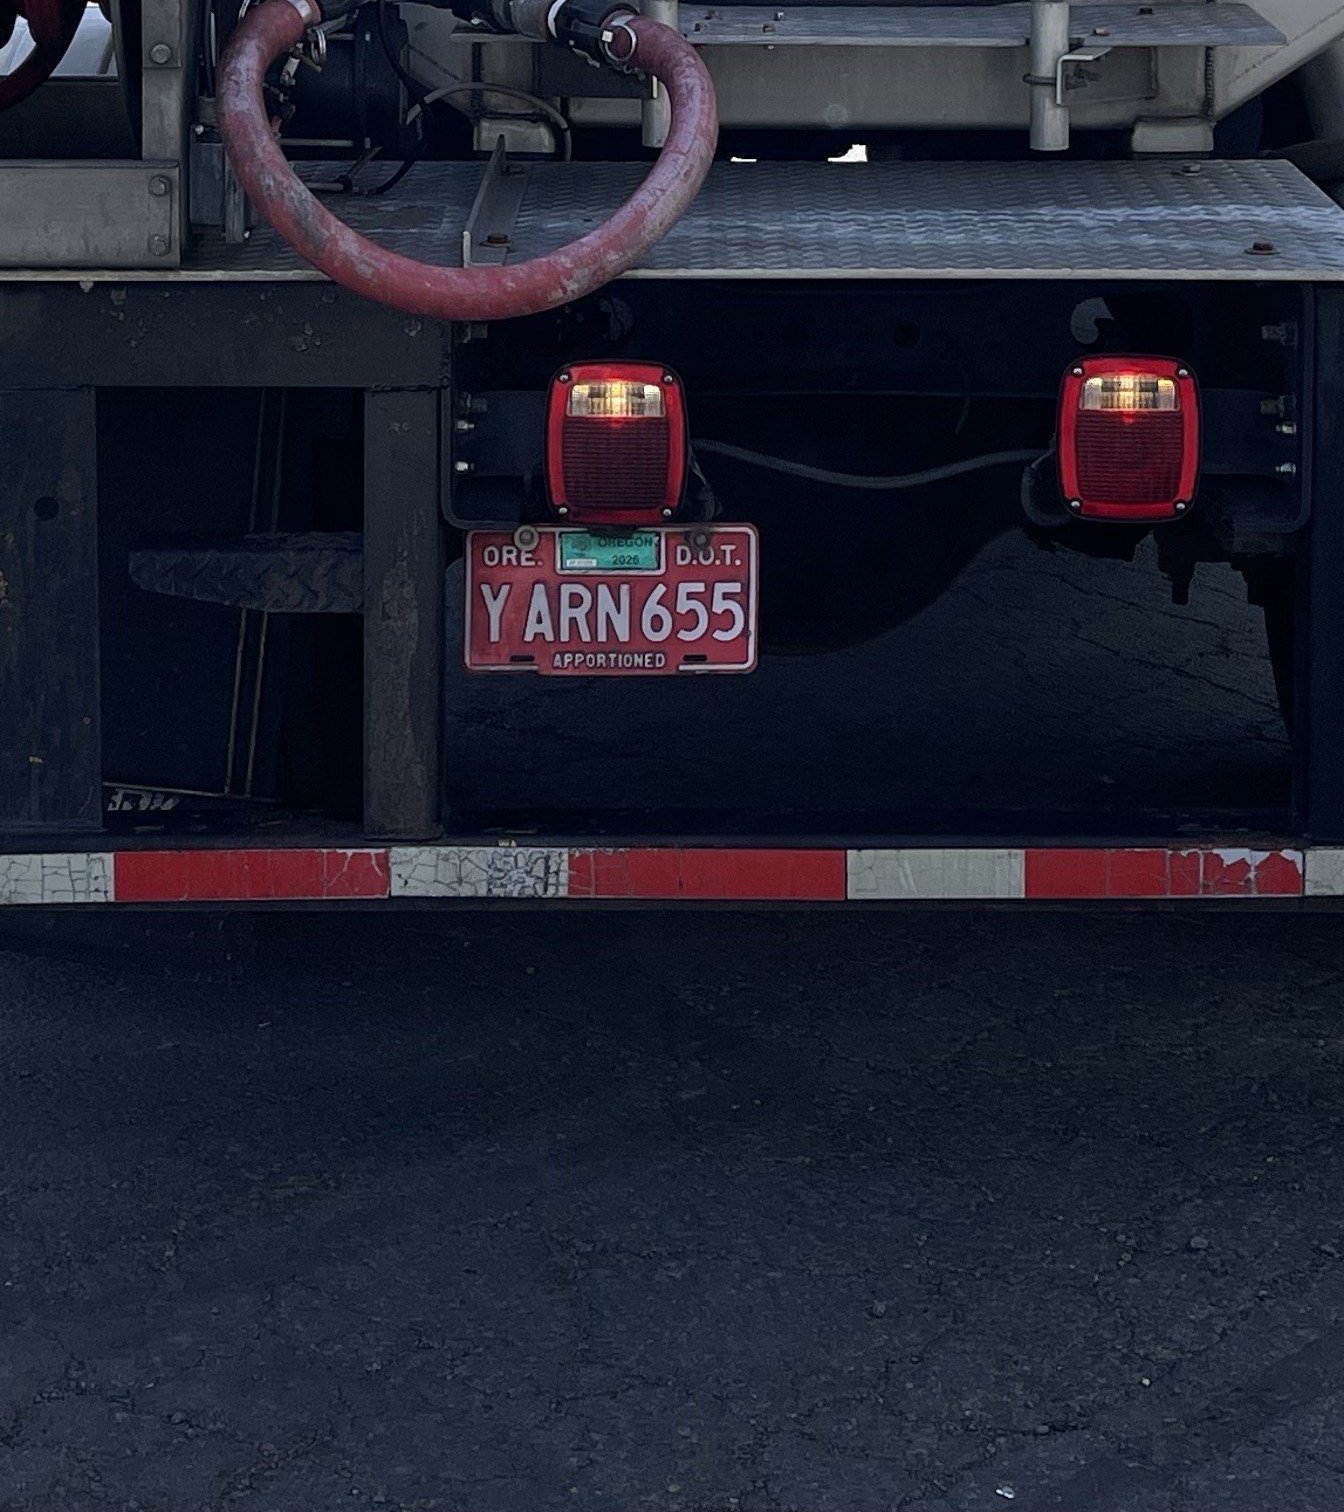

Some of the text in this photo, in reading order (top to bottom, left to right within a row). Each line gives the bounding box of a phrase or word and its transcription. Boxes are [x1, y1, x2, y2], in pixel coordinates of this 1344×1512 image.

[598, 536, 652, 548] OREGON
[483, 544, 741, 567] ORE. D.O.T.
[553, 653, 666, 668] APPORTIONED
